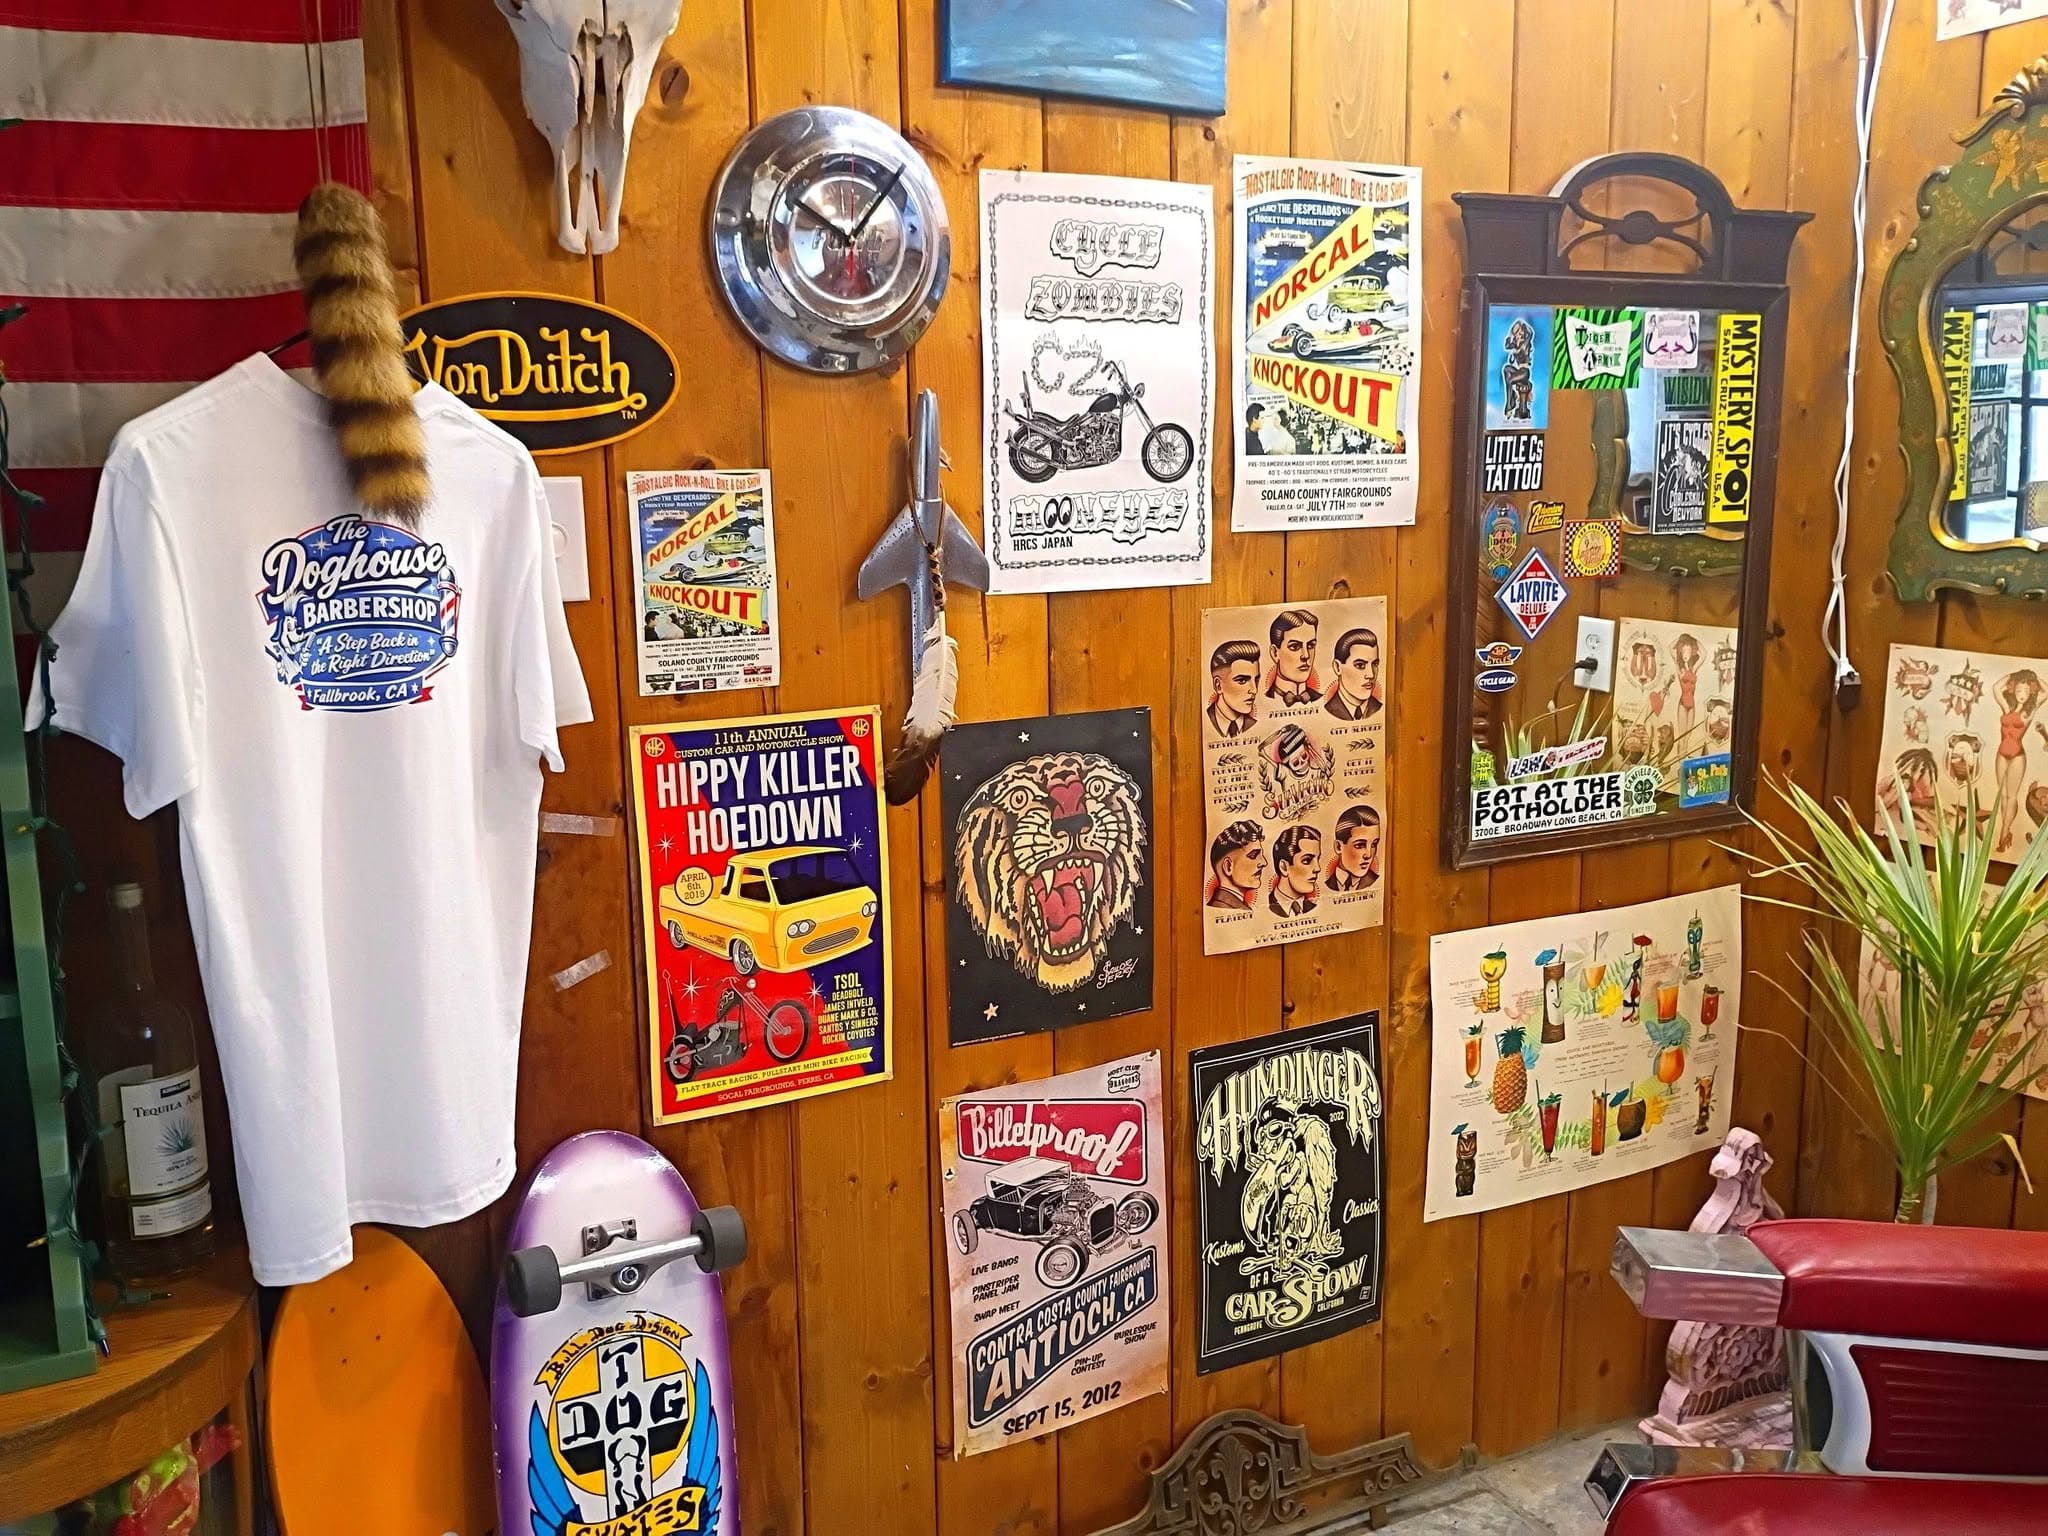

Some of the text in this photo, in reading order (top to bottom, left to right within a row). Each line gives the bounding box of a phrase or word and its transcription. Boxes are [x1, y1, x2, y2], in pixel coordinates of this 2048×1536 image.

[1246, 168, 1295, 199] NOSTALGIC
[1297, 166, 1348, 197] ROCK-N-ROLL
[1350, 179, 1366, 202] BIKE
[1375, 183, 1389, 202] CAR
[1277, 203, 1292, 213] THE
[1292, 203, 1342, 216] DESPERADOS
[1056, 222, 1159, 269] CYCLE
[1256, 224, 1369, 327] NORCAL
[1031, 281, 1181, 319] ZOMBIES
[1722, 329, 1731, 372] SANTA
[404, 327, 642, 403] Von Dutch
[1253, 357, 1393, 427] KNOCKOUT
[621, 410, 637, 420] TM
[1722, 319, 1759, 516] MYSTERY SPOT
[1486, 435, 1543, 463] LITTLE Cs
[1716, 420, 1726, 457] CALIF.
[636, 475, 673, 496] NOSTALGIC
[674, 474, 715, 490] ROCK-N-ROLL
[1484, 463, 1543, 492] TATTOO
[1261, 486, 1392, 501] SOLANO COUNTY FAIRGROUNDS
[1712, 472, 1723, 508] U.S.A.
[1306, 500, 1345, 512] JULY 7TH
[326, 514, 370, 544] The
[650, 503, 735, 569] NORCAL
[1013, 536, 1073, 551] HRCS JAPAN
[263, 540, 446, 604] Doghouse
[649, 585, 757, 620] KNOCKOUT
[1510, 581, 1559, 603] LAYRITE
[303, 596, 437, 629] BARBERSHOP
[1519, 603, 1547, 614] DELUXE
[335, 632, 368, 653] Step
[370, 632, 405, 645] Back
[407, 634, 420, 646] in
[311, 658, 327, 676] the
[328, 651, 367, 675] Right
[658, 654, 760, 668] SOLANO COUNTY FAIRGROUNDS
[1479, 676, 1516, 686] CYCLE GEAR
[313, 682, 409, 704] Fallbrook, CA
[714, 725, 807, 745] 11th ANNUAL
[673, 734, 845, 759] CUSTOM CAR AND MOTORCYCLE SHOW
[656, 745, 864, 809] HIPPY KILLER
[1625, 768, 1651, 790] CANFIELD
[1476, 774, 1621, 809] EAT AT THE
[1475, 791, 1622, 827] POTHOLDER
[686, 794, 843, 855] HOEDOWN
[1504, 818, 1553, 834] BROADWAY
[1554, 815, 1577, 827] LONG
[1610, 810, 1622, 819] CA
[679, 872, 707, 884] APRIL
[686, 881, 702, 891] 6th
[684, 890, 706, 900] 2019
[833, 972, 862, 990] TSOL
[831, 987, 865, 1002] DEADBOLT
[817, 1012, 840, 1025] DUANE
[840, 1009, 859, 1021] MARK
[823, 1000, 846, 1014] JAMES
[818, 1016, 879, 1036] SANTOS Y SINNERS
[822, 1027, 876, 1046] ROCKIN COYOTES
[681, 1051, 869, 1094] FLAT TRACK RACING, PULLSTART MINI BIKE RACING
[717, 1091, 745, 1102] SOCAL
[744, 1081, 797, 1098] FAIRGROUNDS,
[823, 1073, 835, 1081] CA
[132, 1102, 184, 1119] TEQUILA
[1197, 1047, 1382, 1188] HUMDINGER
[1329, 1111, 1345, 1122] 2022
[962, 1103, 1139, 1176] Billetproof
[1342, 1199, 1380, 1224] Classics
[1202, 1238, 1246, 1266] Kustoms
[971, 1256, 1020, 1276] LIVE BANDS
[972, 1274, 1020, 1295] PINSTRIPER
[1225, 1254, 1369, 1328] CAR SHOW
[1250, 1271, 1269, 1289] OF A
[973, 1283, 1020, 1304] PANEL JAM
[973, 1301, 1021, 1323] SWAP MEET
[976, 1254, 1152, 1372] CONTRA COSTA COUNTY FAIRGROUNDS
[1317, 1297, 1345, 1313] CALIFORNIA
[1113, 1322, 1158, 1341] BURLESQUE
[1124, 1333, 1147, 1346] SHOW
[983, 1276, 1146, 1412] ANTIOCH, CA
[1071, 1360, 1107, 1376] CONTEST
[1074, 1353, 1104, 1368] PIN-UP
[1003, 1380, 1123, 1436] SEPT 15, 2012
